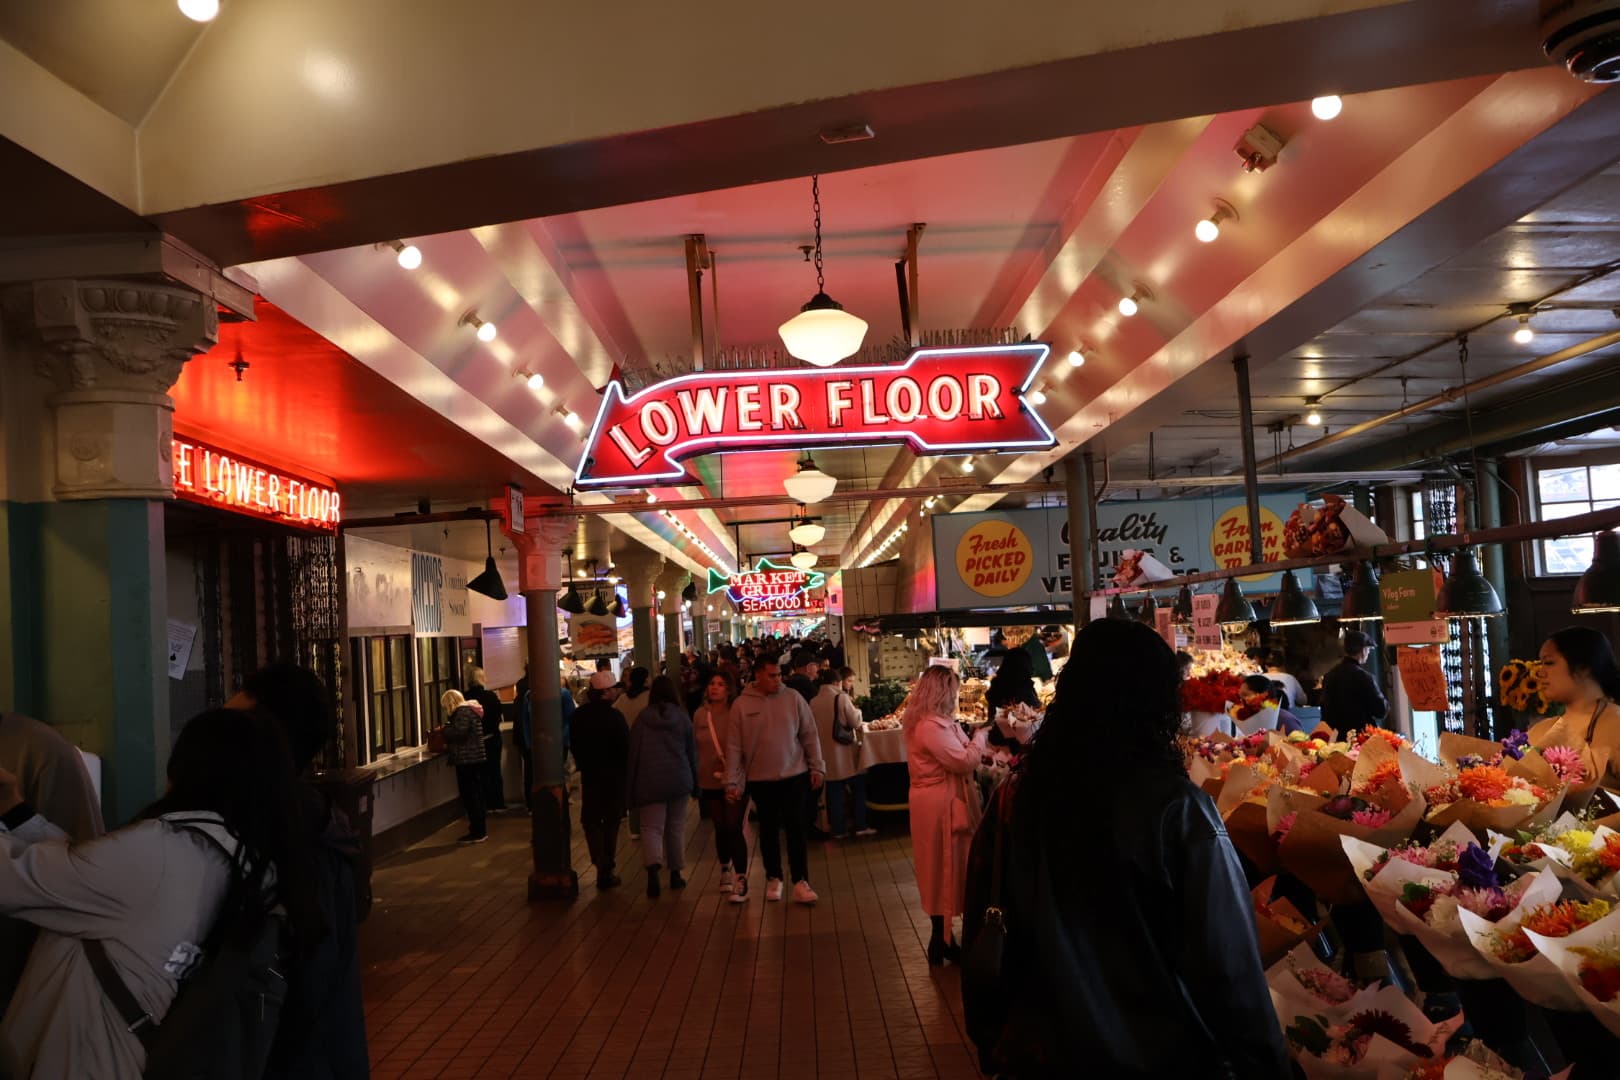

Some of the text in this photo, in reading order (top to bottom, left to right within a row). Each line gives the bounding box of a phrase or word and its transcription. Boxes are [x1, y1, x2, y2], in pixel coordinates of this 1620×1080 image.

[606, 373, 1005, 470] LOWER FLOOR
[205, 449, 280, 511] LOWER
[288, 480, 340, 523] FLOOR
[1061, 511, 1169, 545] ality
[1221, 517, 1274, 539] Frm
[969, 527, 1018, 555] Fresh
[1214, 535, 1278, 556] GARDN
[966, 551, 1026, 572] PICKED
[1170, 546, 1185, 563] &
[730, 571, 806, 586] MARKET
[974, 568, 1020, 588] DAILY
[741, 583, 796, 598] GRILL
[742, 597, 801, 612] SEAFOOD
